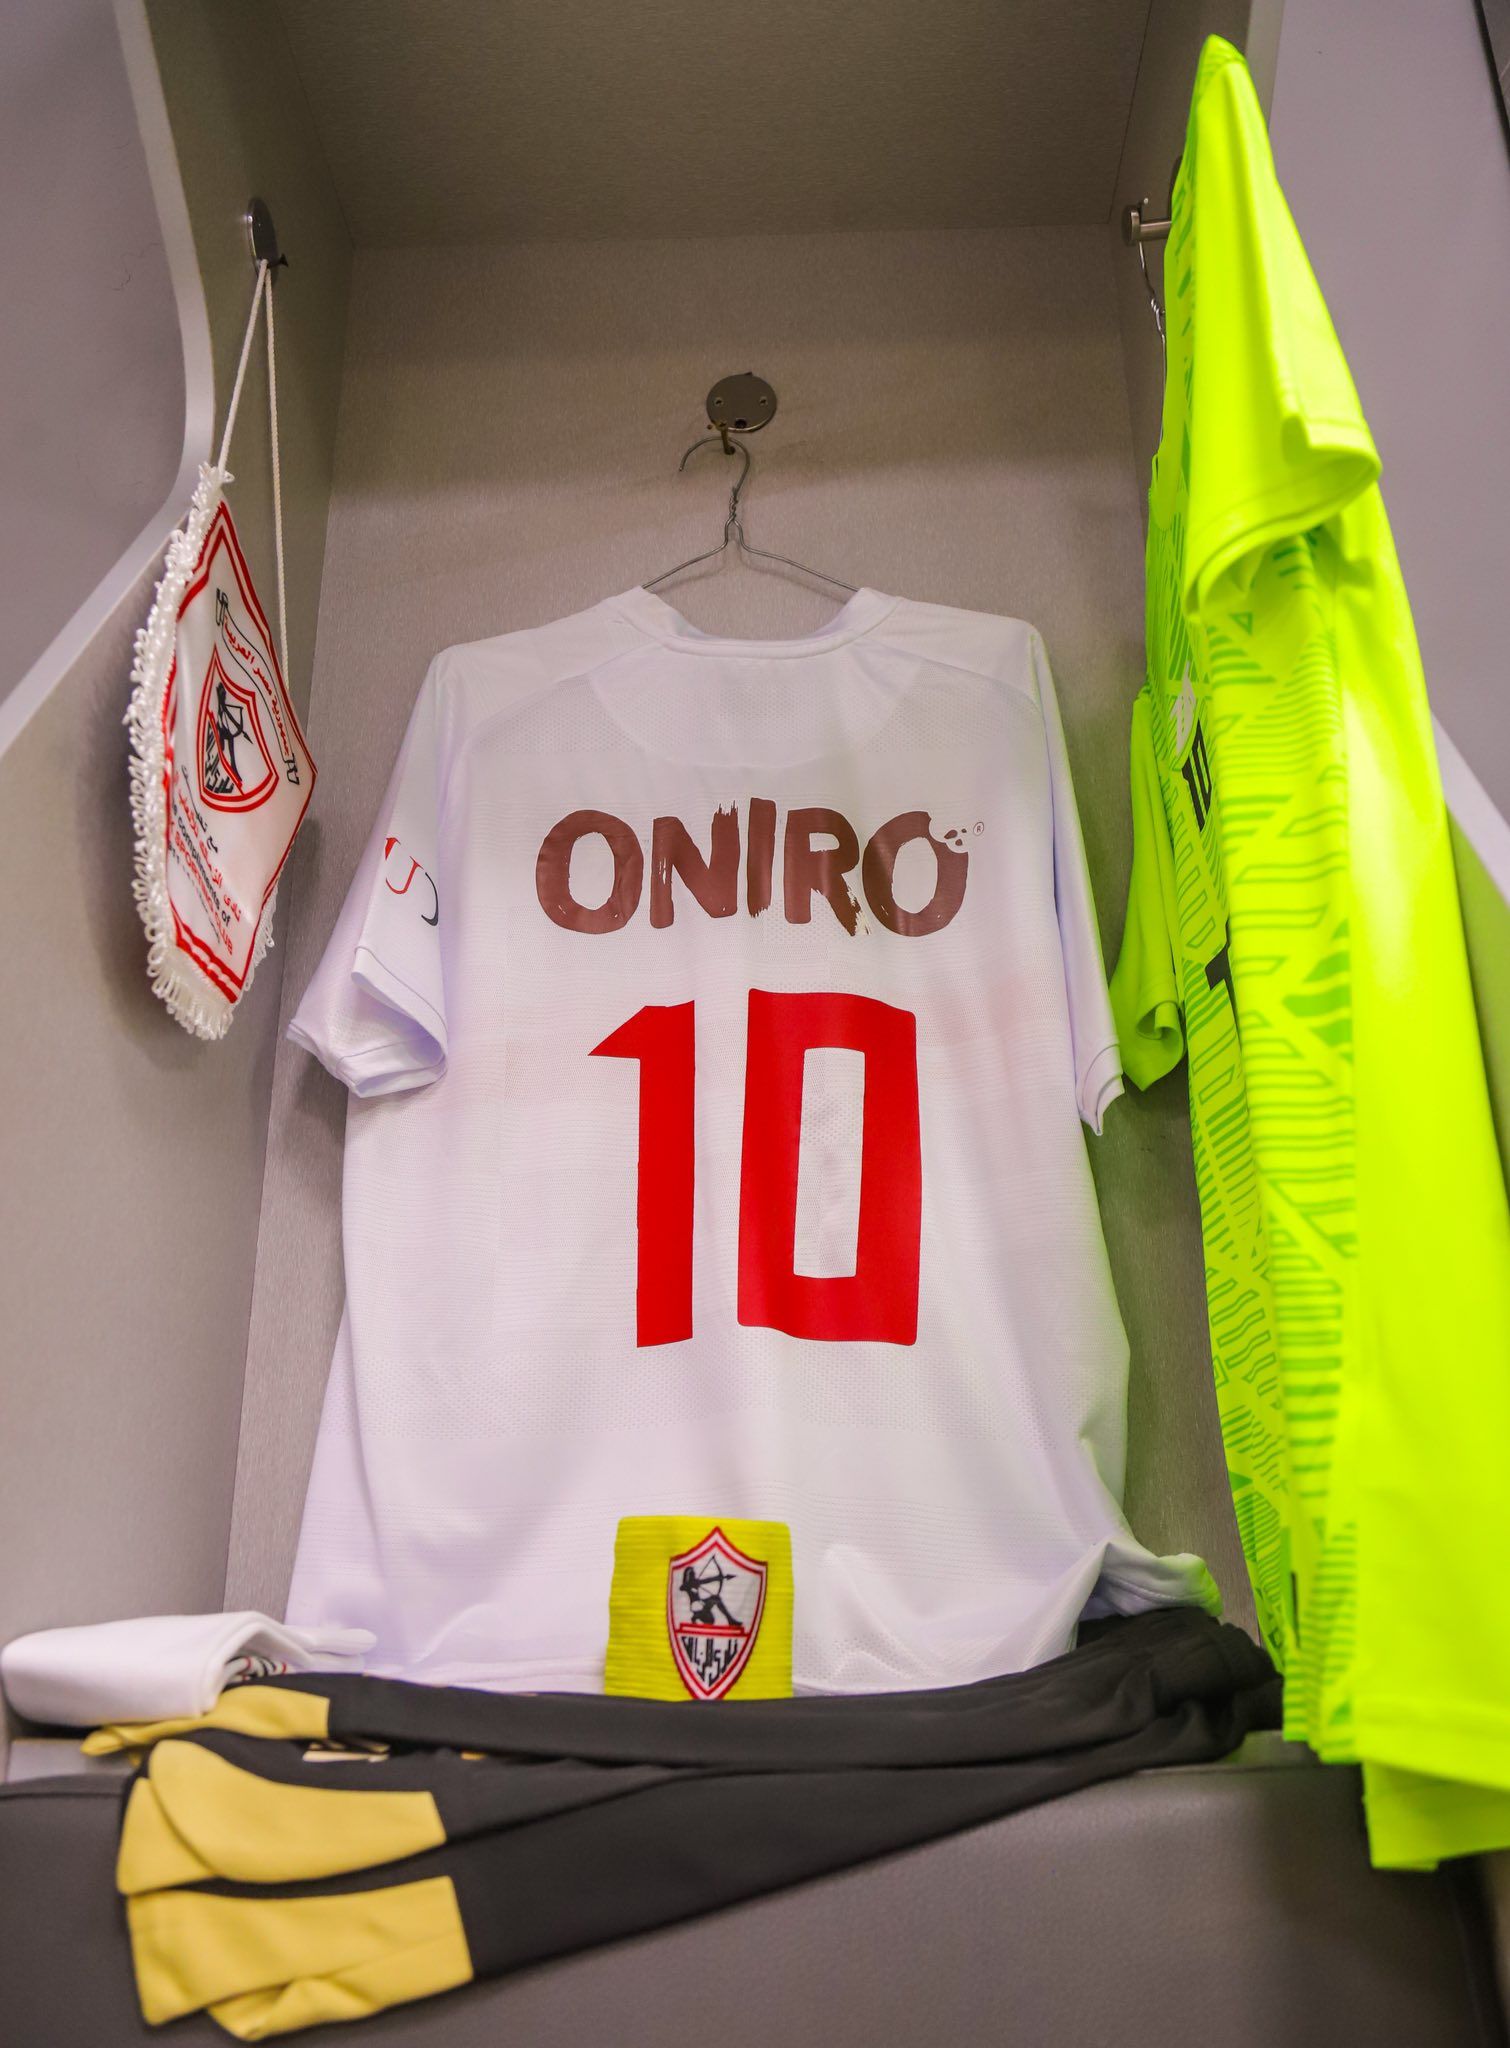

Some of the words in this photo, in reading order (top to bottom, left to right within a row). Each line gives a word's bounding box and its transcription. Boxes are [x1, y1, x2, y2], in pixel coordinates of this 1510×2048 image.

[253, 667, 272, 696] مصر
[175, 831, 214, 912] SPORTING
[214, 911, 233, 955] CLUB
[178, 816, 220, 910] compliments
[221, 910, 231, 926] of
[536, 797, 969, 937] ONIRO
[588, 988, 922, 1348] 10
